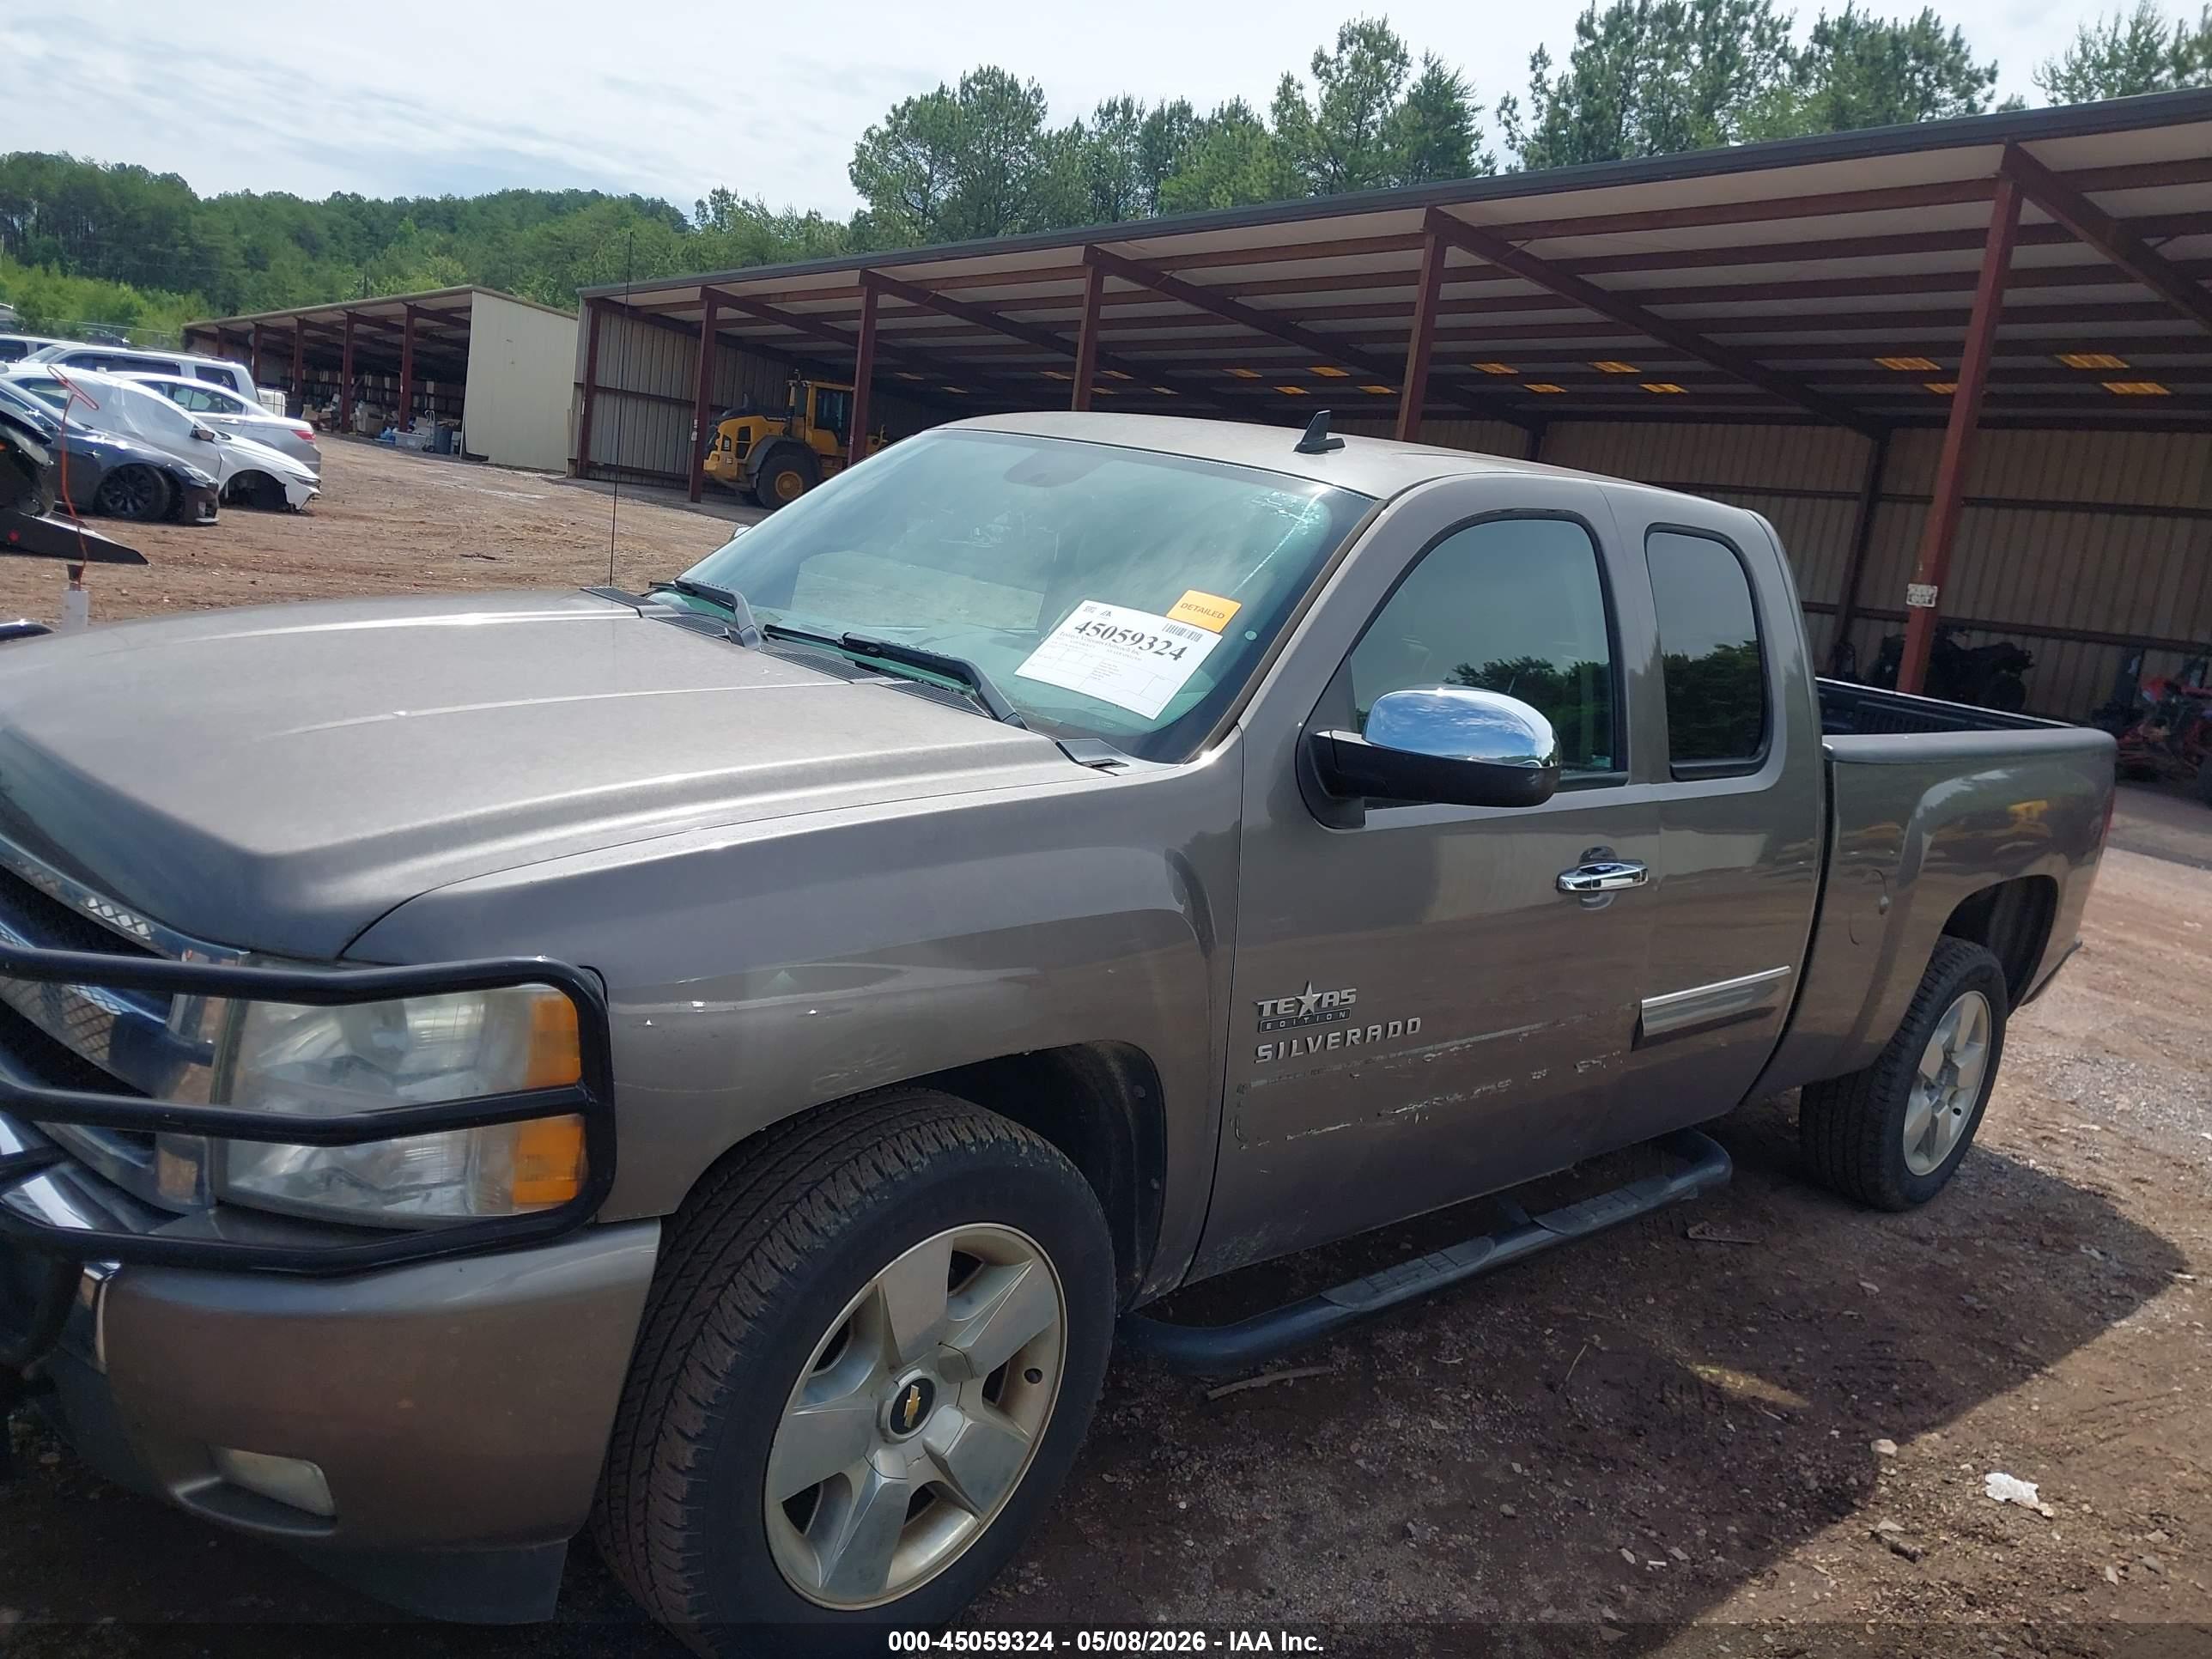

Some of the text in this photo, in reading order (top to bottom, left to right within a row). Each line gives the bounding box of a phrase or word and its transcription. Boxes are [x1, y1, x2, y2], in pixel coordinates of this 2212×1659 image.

[1181, 602, 1224, 620] DETAILED
[1074, 620, 1188, 661] 45059324
[1266, 1012, 1346, 1030] EDITION
[1255, 1018, 1421, 1063] SILVERADO
